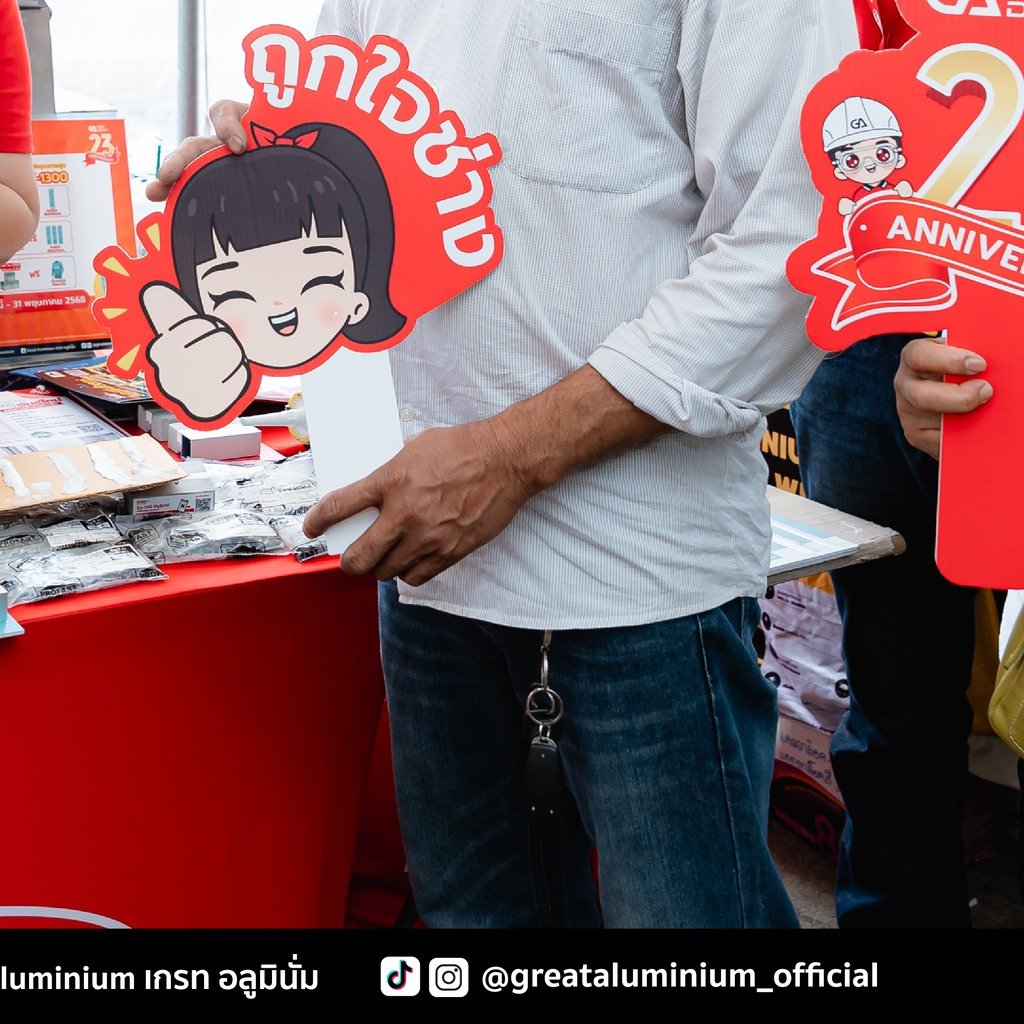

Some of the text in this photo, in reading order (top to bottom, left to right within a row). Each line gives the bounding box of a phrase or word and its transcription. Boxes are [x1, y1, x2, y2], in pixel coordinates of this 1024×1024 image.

[88, 133, 115, 157] 23
[251, 34, 495, 267] ถูกใจช่าง
[886, 215, 1024, 274] ANNIVE
[13, 300, 22, 308] 31
[64, 296, 86, 305] 2568
